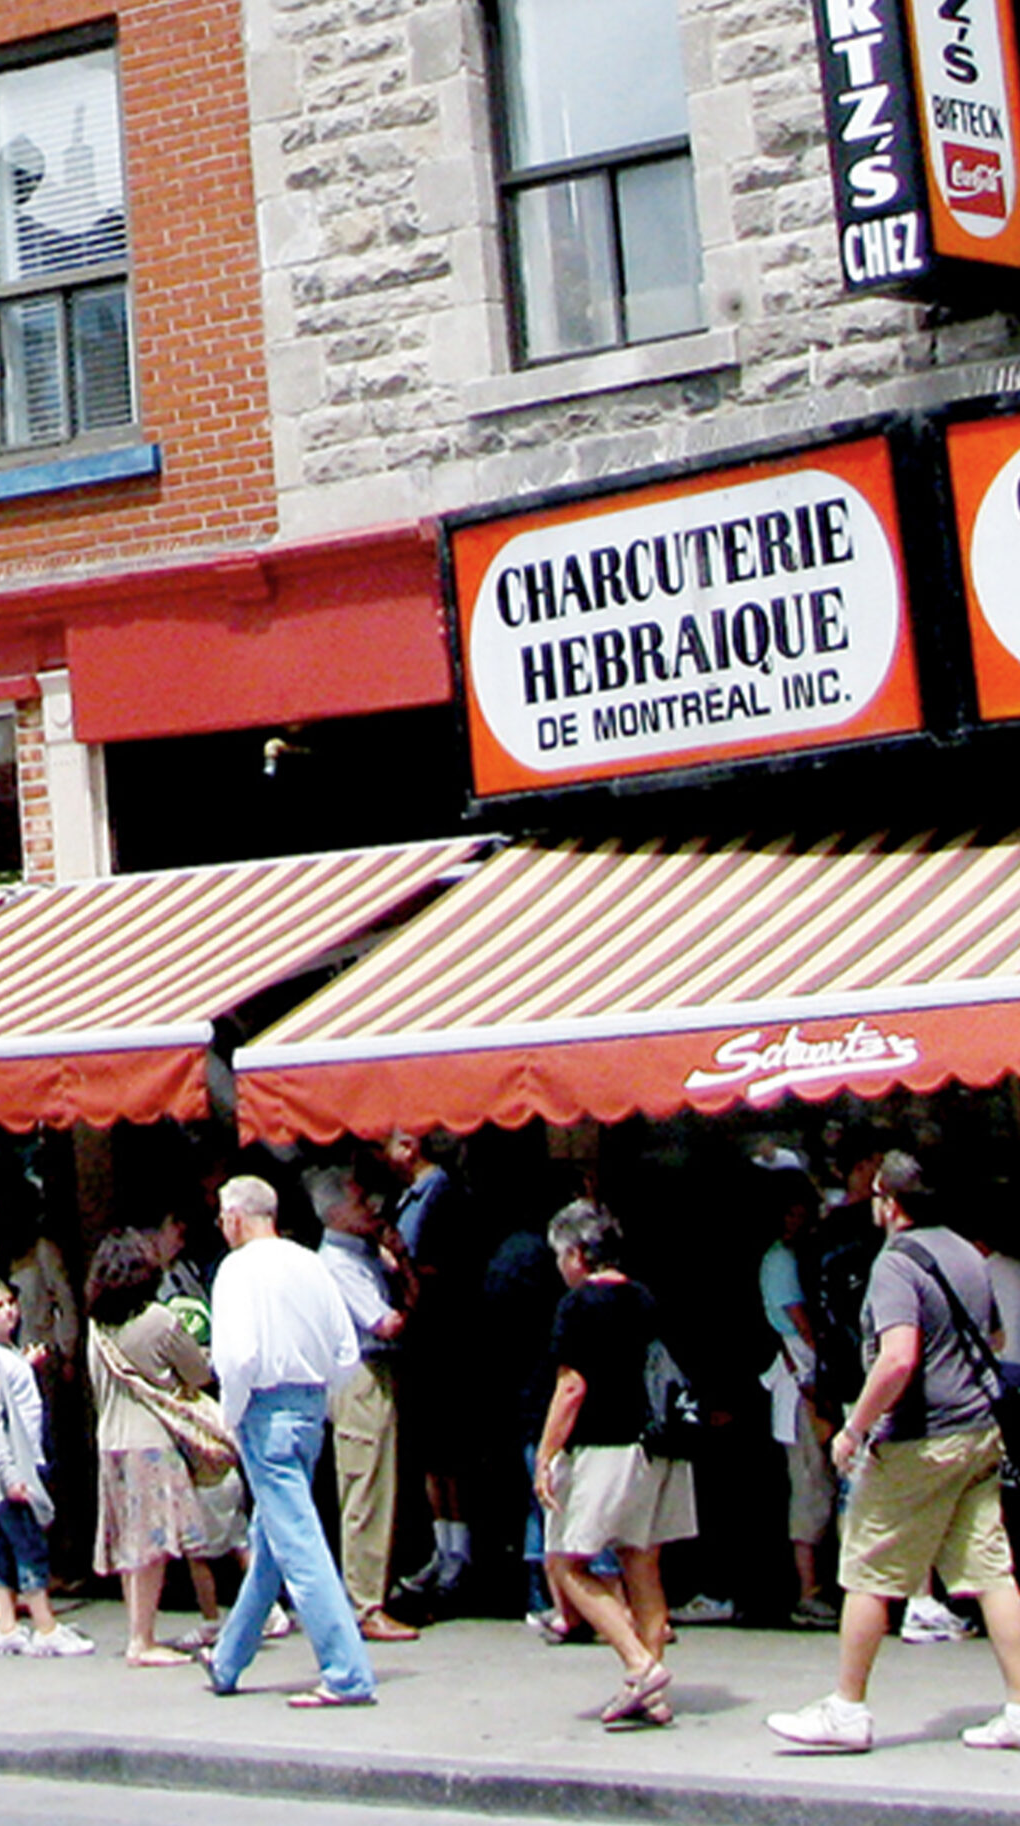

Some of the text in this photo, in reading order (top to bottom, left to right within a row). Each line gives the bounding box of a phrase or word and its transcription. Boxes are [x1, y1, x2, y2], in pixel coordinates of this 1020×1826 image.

[931, 94, 1004, 140] BIFTECK
[843, 211, 923, 282] CHEZ
[496, 498, 855, 627] CHARCUTERIE
[521, 586, 849, 705] HEBRAIQUE
[537, 713, 578, 751] DE
[782, 668, 852, 710] INC.
